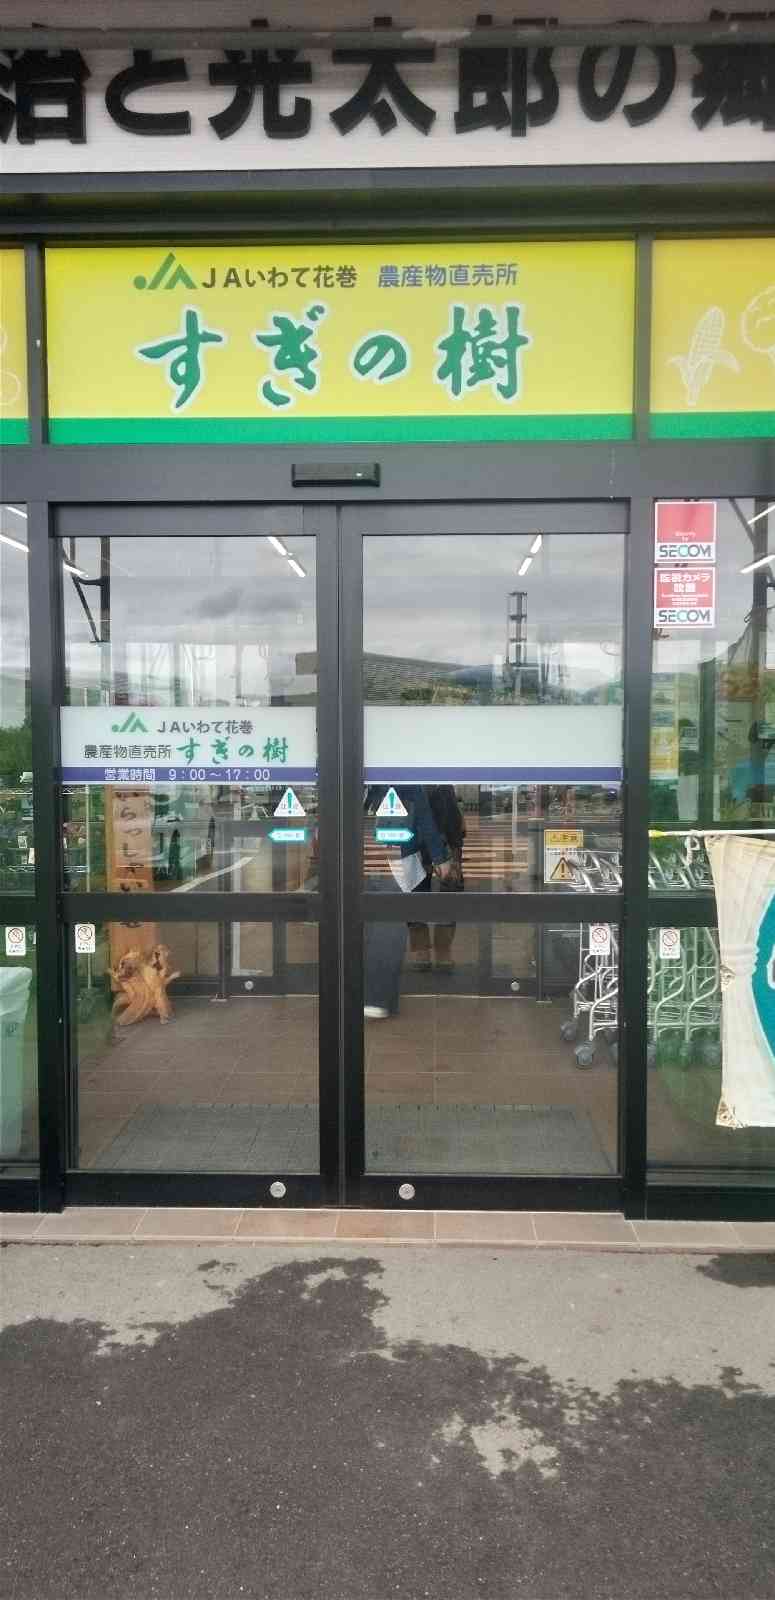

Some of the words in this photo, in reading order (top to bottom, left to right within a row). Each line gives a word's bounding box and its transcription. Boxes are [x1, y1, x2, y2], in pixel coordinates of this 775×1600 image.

[202, 266, 358, 289] JAいわて花巻
[377, 262, 519, 289] 農産物直売所
[137, 304, 530, 410] すぎの樹
[659, 544, 712, 558] SECOM
[658, 609, 711, 623] SECOM
[157, 720, 254, 735] JAいわて花巻
[84, 744, 172, 760] 農産物直売所
[176, 736, 289, 765] すぎの樹
[104, 768, 156, 782] 営業時間
